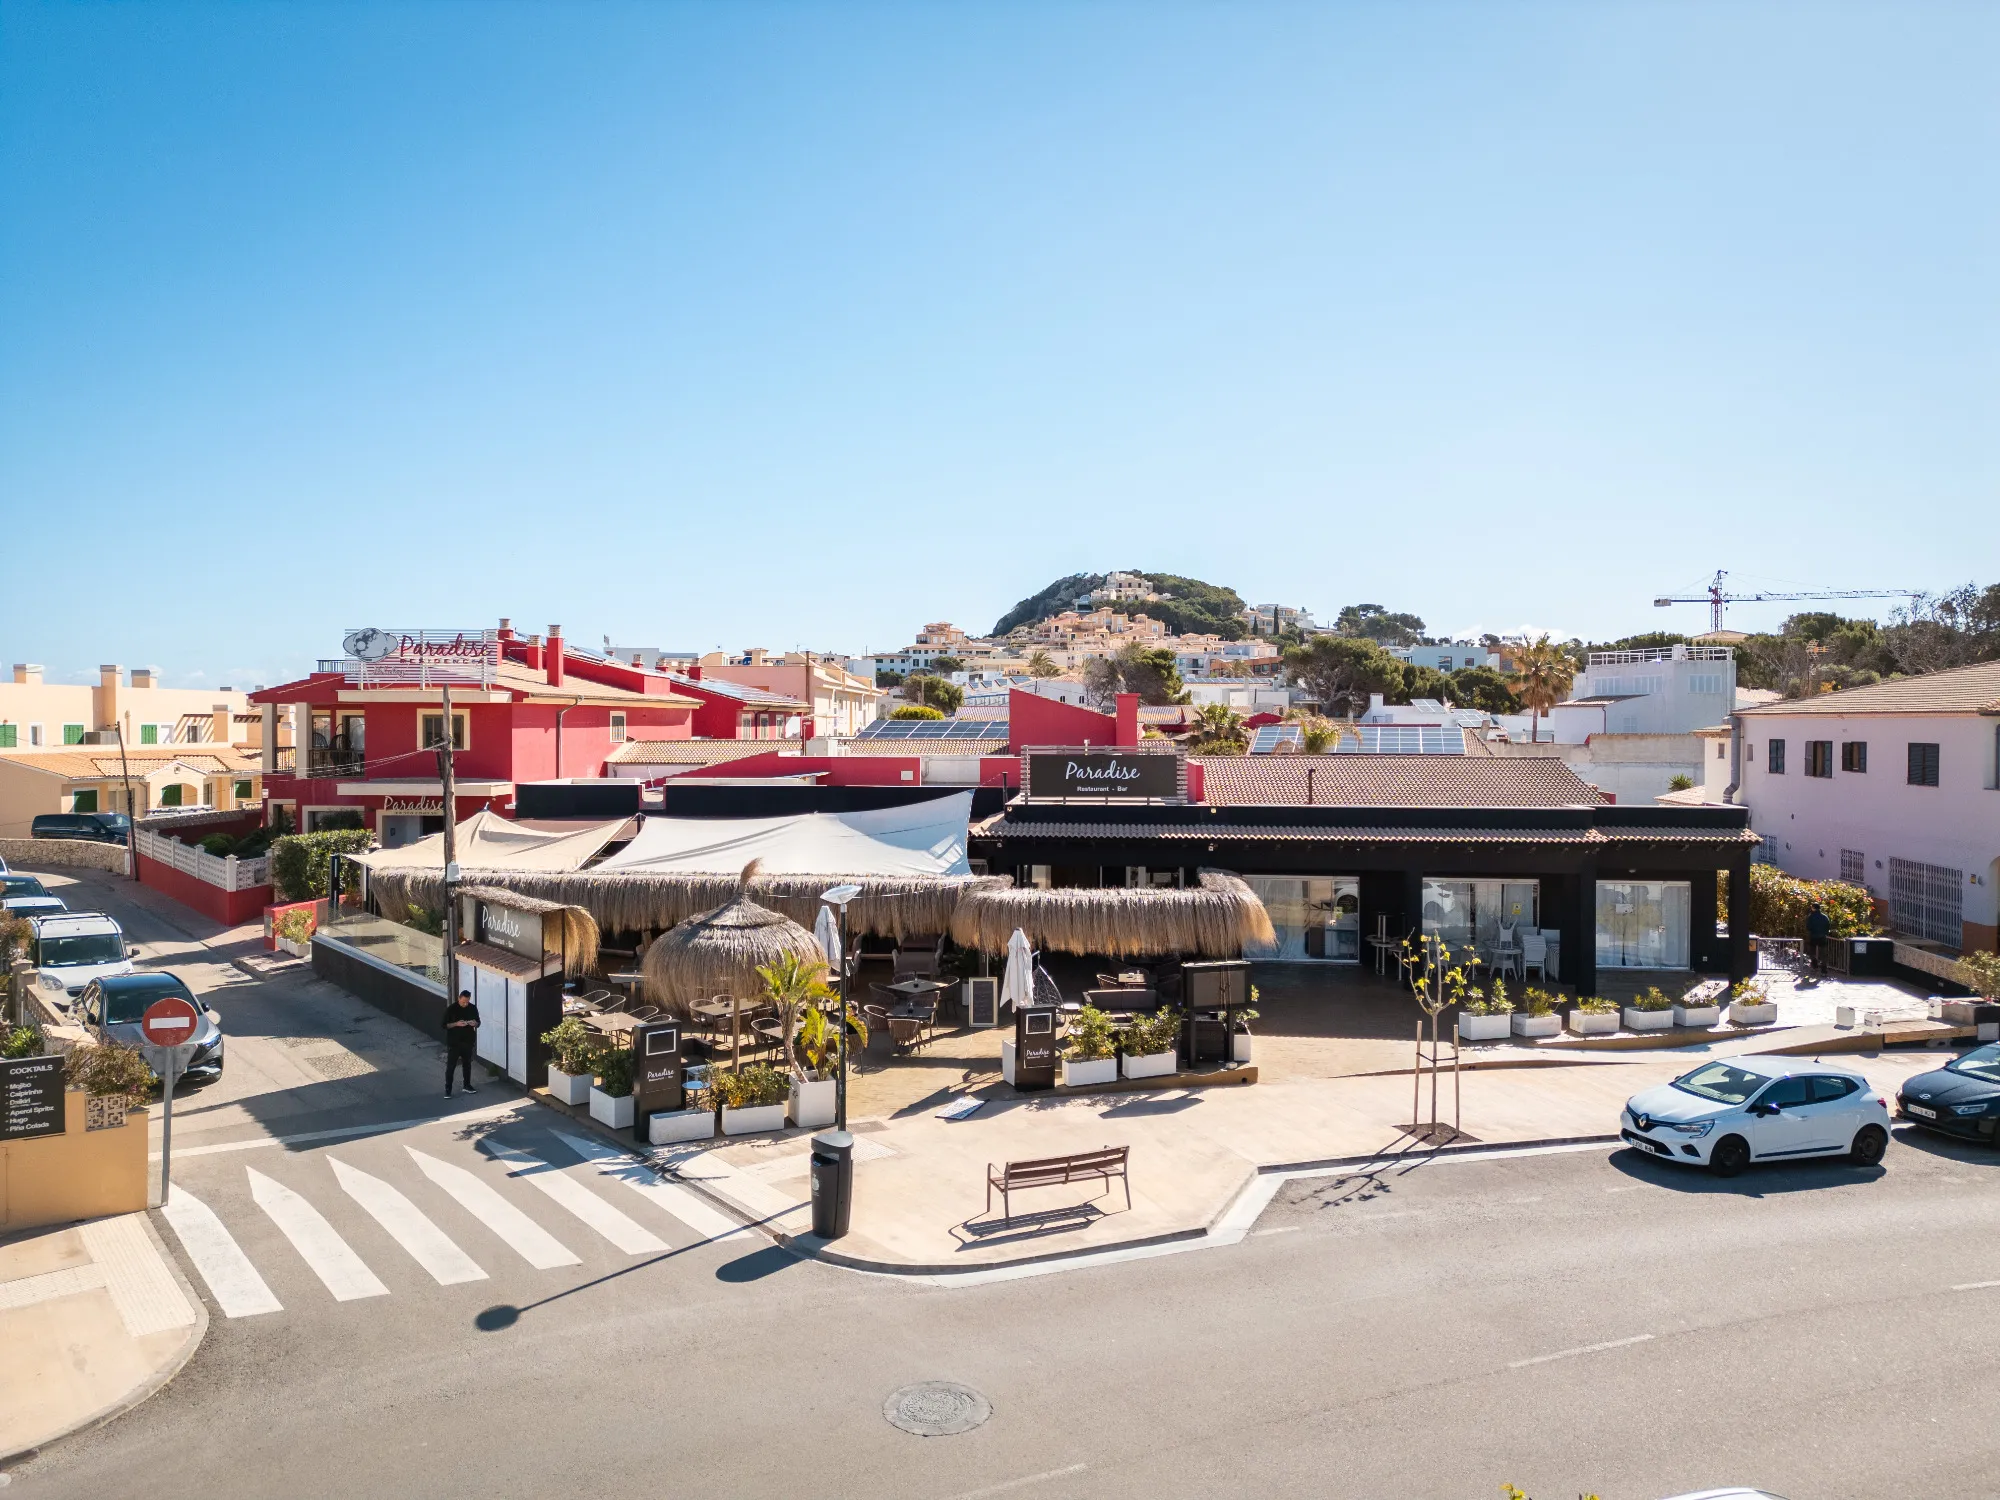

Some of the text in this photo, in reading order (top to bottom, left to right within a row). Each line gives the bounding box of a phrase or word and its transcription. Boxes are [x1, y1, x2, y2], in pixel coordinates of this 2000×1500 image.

[400, 633, 493, 658] Paradise
[1065, 760, 1141, 780] Paradise
[384, 795, 444, 812] Paradise
[482, 905, 520, 938] Paradise
[10, 1064, 53, 1074] COCKTAILS
[647, 1068, 674, 1079] Paradise
[10, 1089, 43, 1097] Caipirinha
[10, 1108, 32, 1116] Aperol
